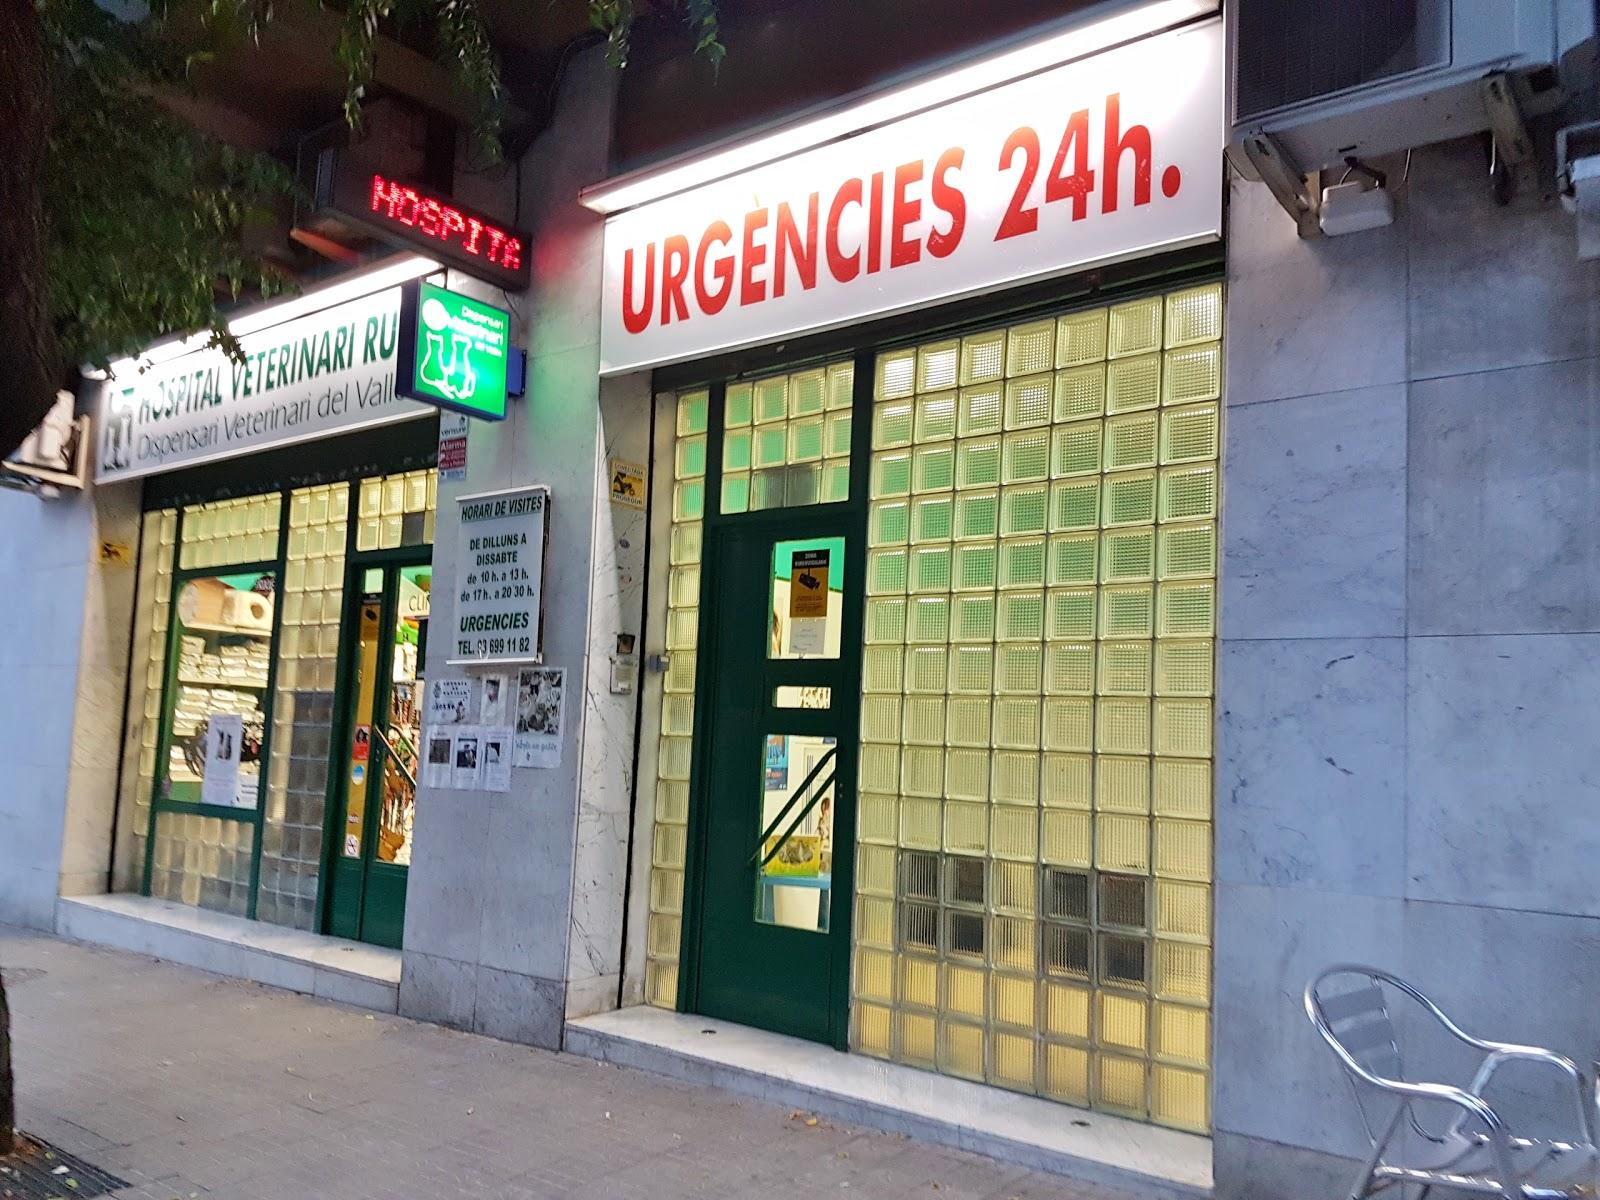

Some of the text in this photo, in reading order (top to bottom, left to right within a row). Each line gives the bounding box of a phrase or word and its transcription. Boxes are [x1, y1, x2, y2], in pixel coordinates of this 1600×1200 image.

[622, 92, 1181, 334] URGÈNCIES 24h.
[139, 310, 398, 425] HOSPITAL VETERINARI RU
[138, 416, 220, 465] Dispensari
[224, 391, 311, 441] Veterinari
[318, 383, 349, 419] del
[462, 496, 542, 520] HORARI DE VISITES
[470, 533, 527, 550] DE DILLUNS A
[476, 551, 518, 567] DISSABTE
[467, 573, 477, 585] de
[481, 571, 490, 583] 10
[501, 572, 507, 581] a
[510, 568, 519, 580] 13
[521, 568, 529, 580] h.
[461, 590, 470, 602] de
[473, 589, 482, 601] 17
[494, 591, 500, 600] a
[526, 585, 535, 597] h.
[460, 612, 530, 632] URGENCIES
[458, 640, 475, 655] TEL.
[489, 638, 505, 653] 699
[507, 637, 516, 652] 11
[518, 637, 530, 652] 82
